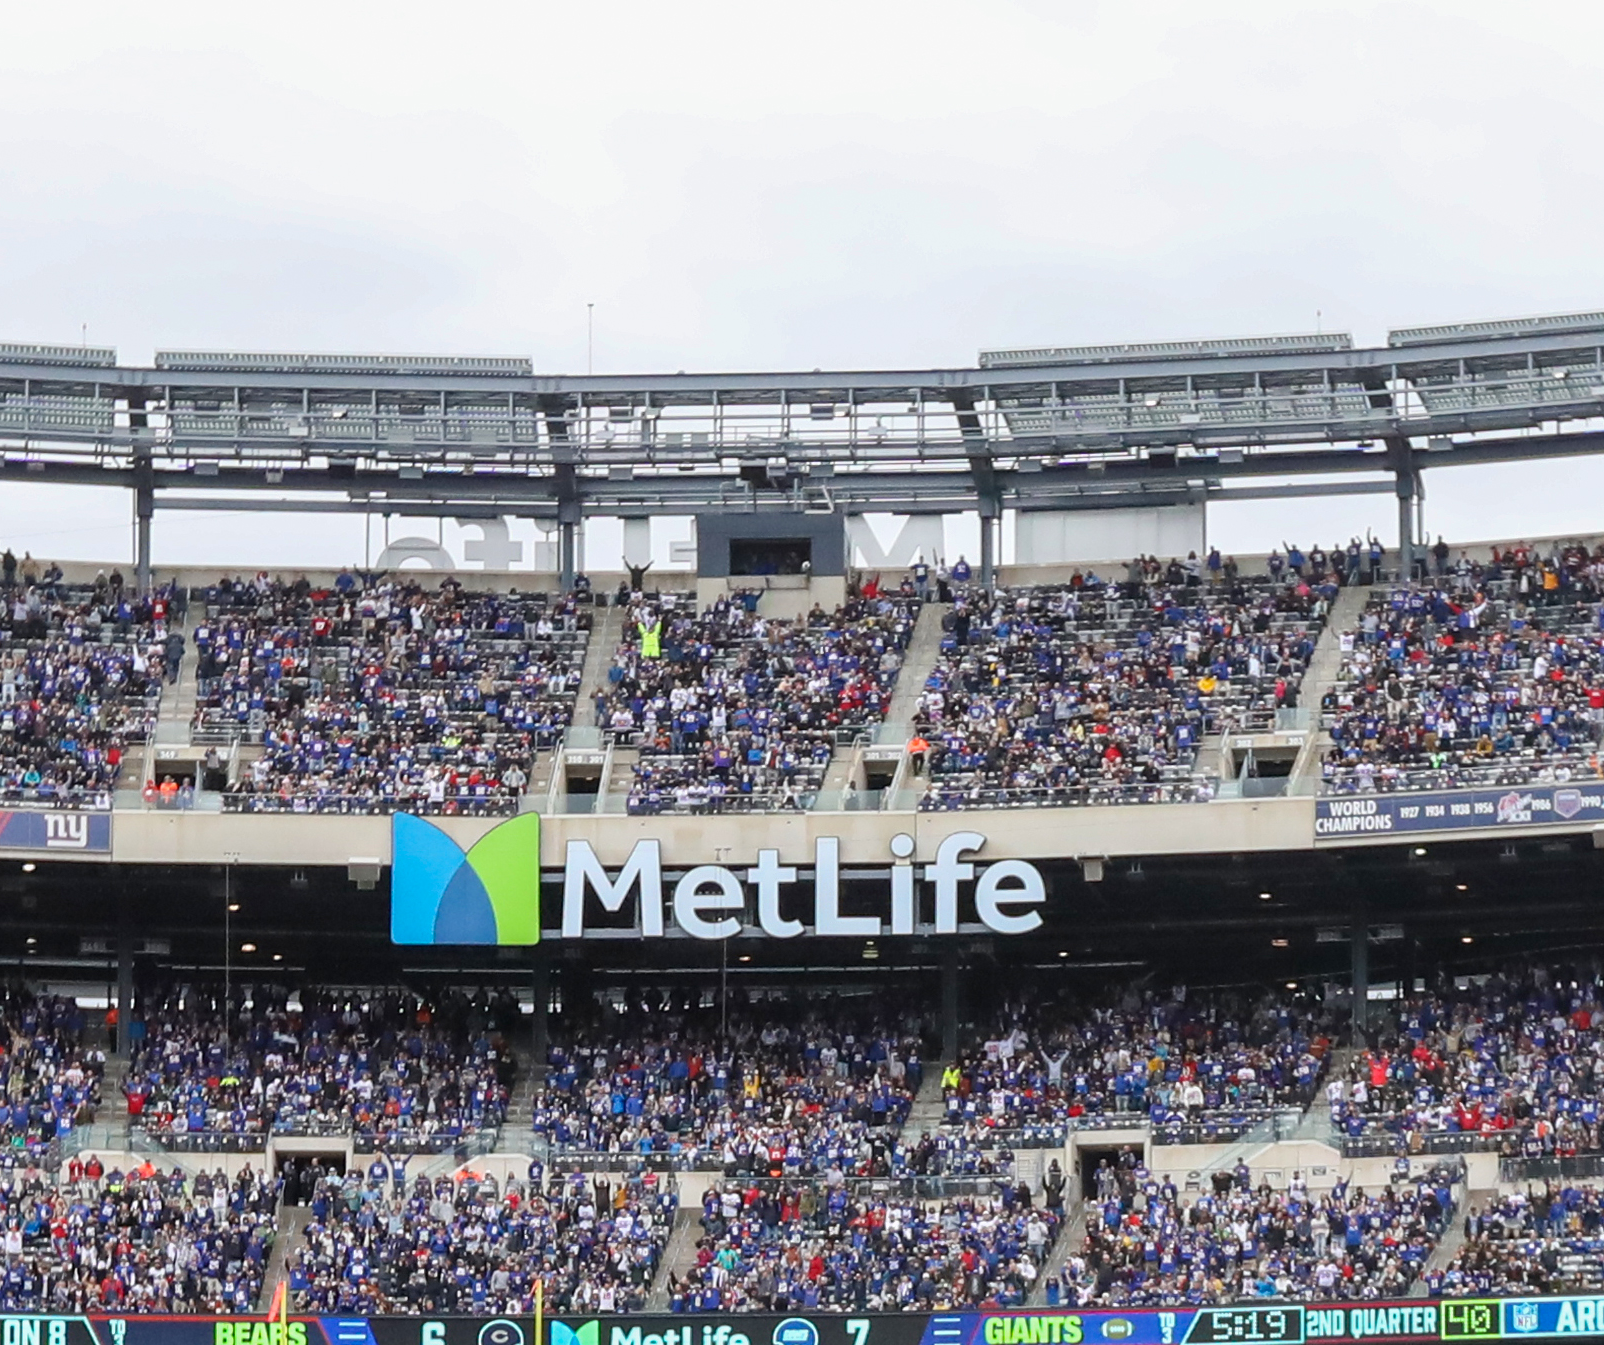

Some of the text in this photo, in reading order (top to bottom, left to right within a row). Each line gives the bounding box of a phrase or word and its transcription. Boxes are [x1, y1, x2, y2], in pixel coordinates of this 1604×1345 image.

[1330, 800, 1377, 816] WORLD
[1400, 806, 1419, 818] 1927
[1425, 805, 1444, 817] 1934
[1450, 803, 1470, 816] 1938
[1474, 802, 1494, 814] 1956
[1531, 798, 1551, 811] 1986
[1316, 815, 1392, 833] CHAMPIONS
[561, 830, 1047, 939] MetLife
[109, 1319, 125, 1334] TO
[1158, 1312, 1176, 1328] TO
[1212, 1312, 1286, 1340] 5:19
[1307, 1306, 1437, 1339] 2ND QUARTER
[1449, 1304, 1491, 1331] 40
[984, 1315, 1083, 1345] GIANTS
[1161, 1328, 1173, 1345] 3
